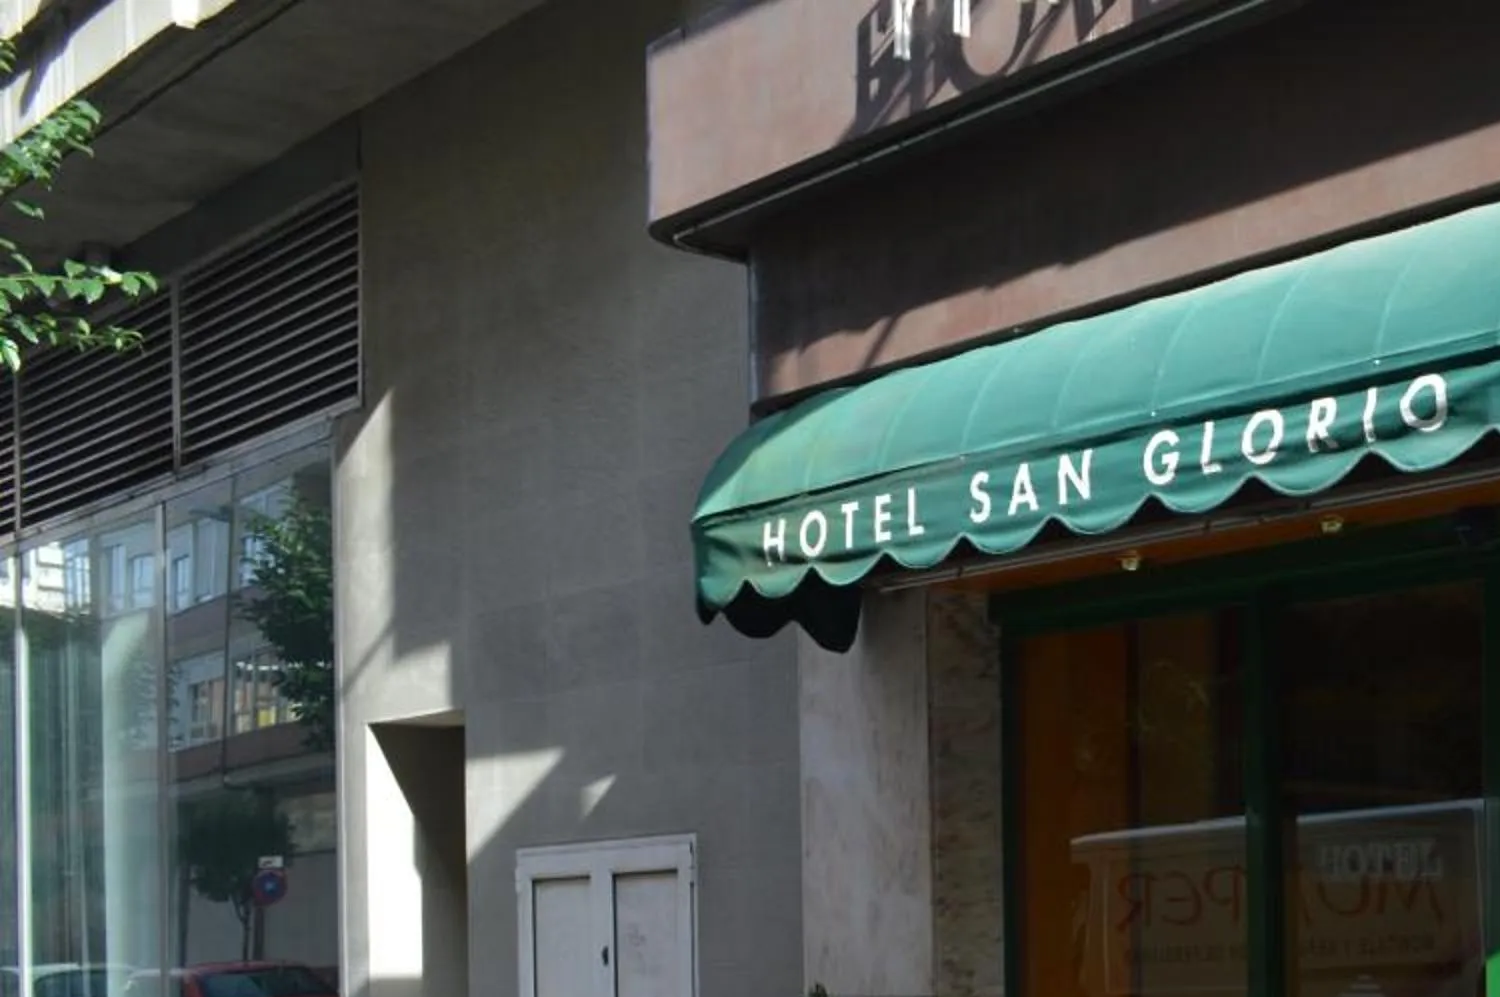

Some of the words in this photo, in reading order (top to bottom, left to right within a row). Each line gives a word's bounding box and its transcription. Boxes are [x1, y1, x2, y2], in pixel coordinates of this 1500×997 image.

[761, 486, 926, 566] HOTEL
[969, 449, 1094, 524] SAN
[1143, 373, 1449, 485] GLORIO
